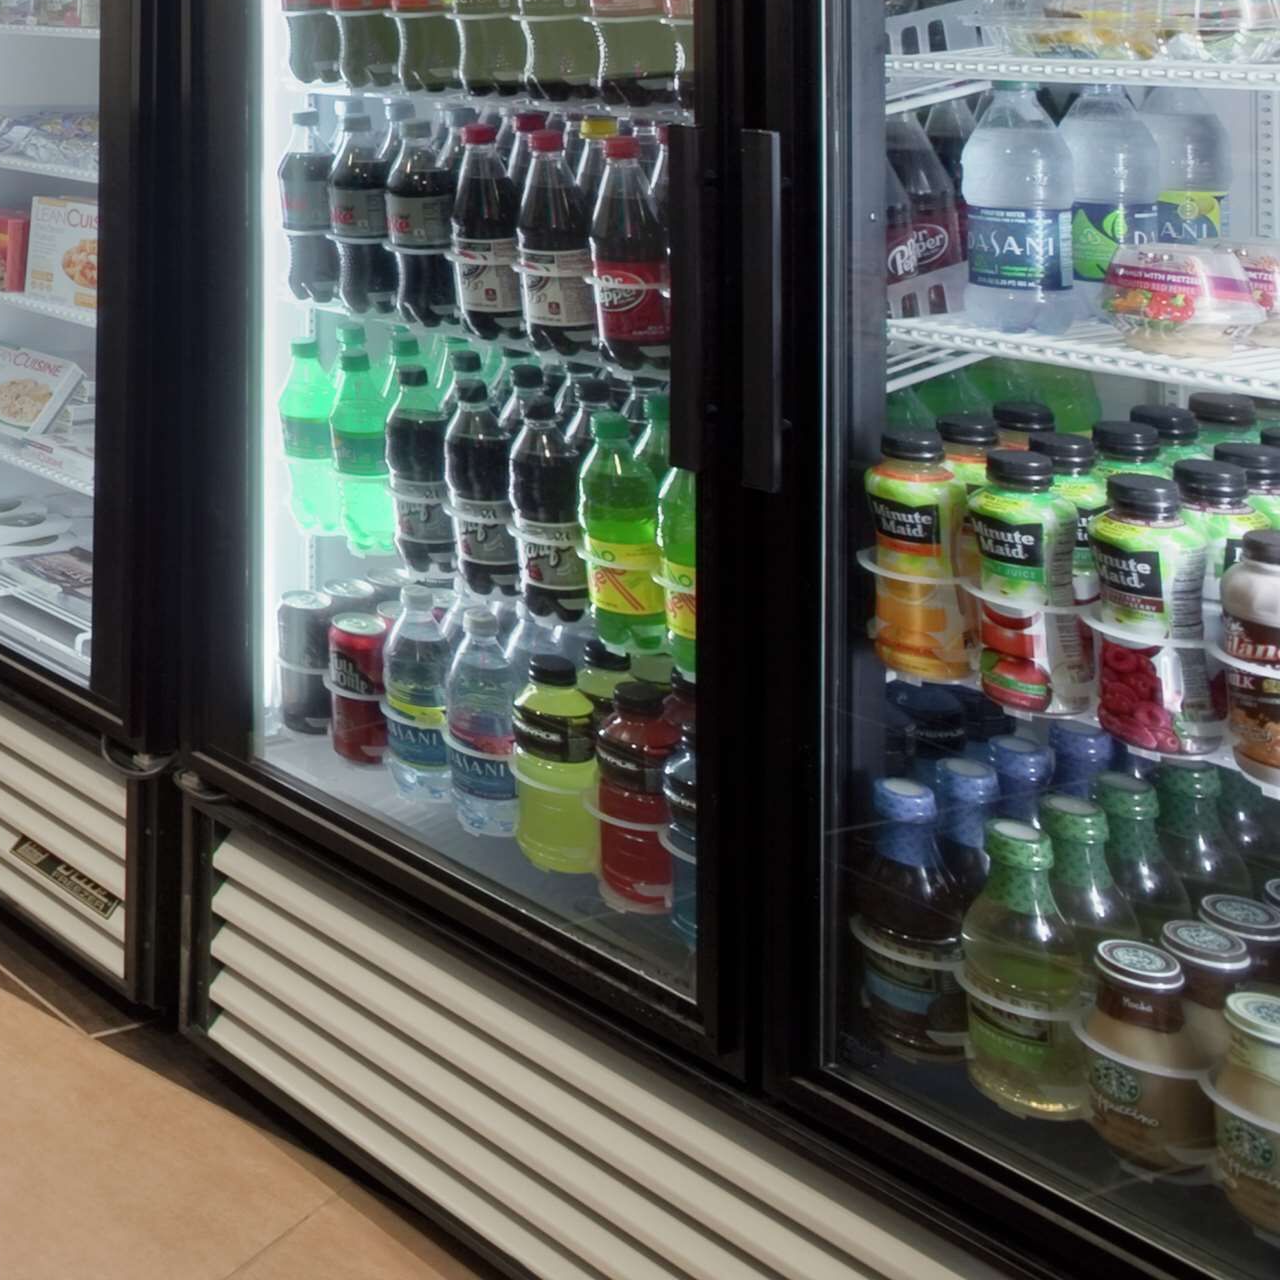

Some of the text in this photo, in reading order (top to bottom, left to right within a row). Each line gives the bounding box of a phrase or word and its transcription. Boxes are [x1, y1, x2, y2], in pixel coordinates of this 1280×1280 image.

[968, 230, 1054, 257] DASANI
[874, 500, 933, 524] Minute
[882, 521, 925, 538] Maid
[974, 518, 1035, 546] Minute
[981, 535, 1027, 560] Maid
[51, 869, 106, 912] FREEZER
